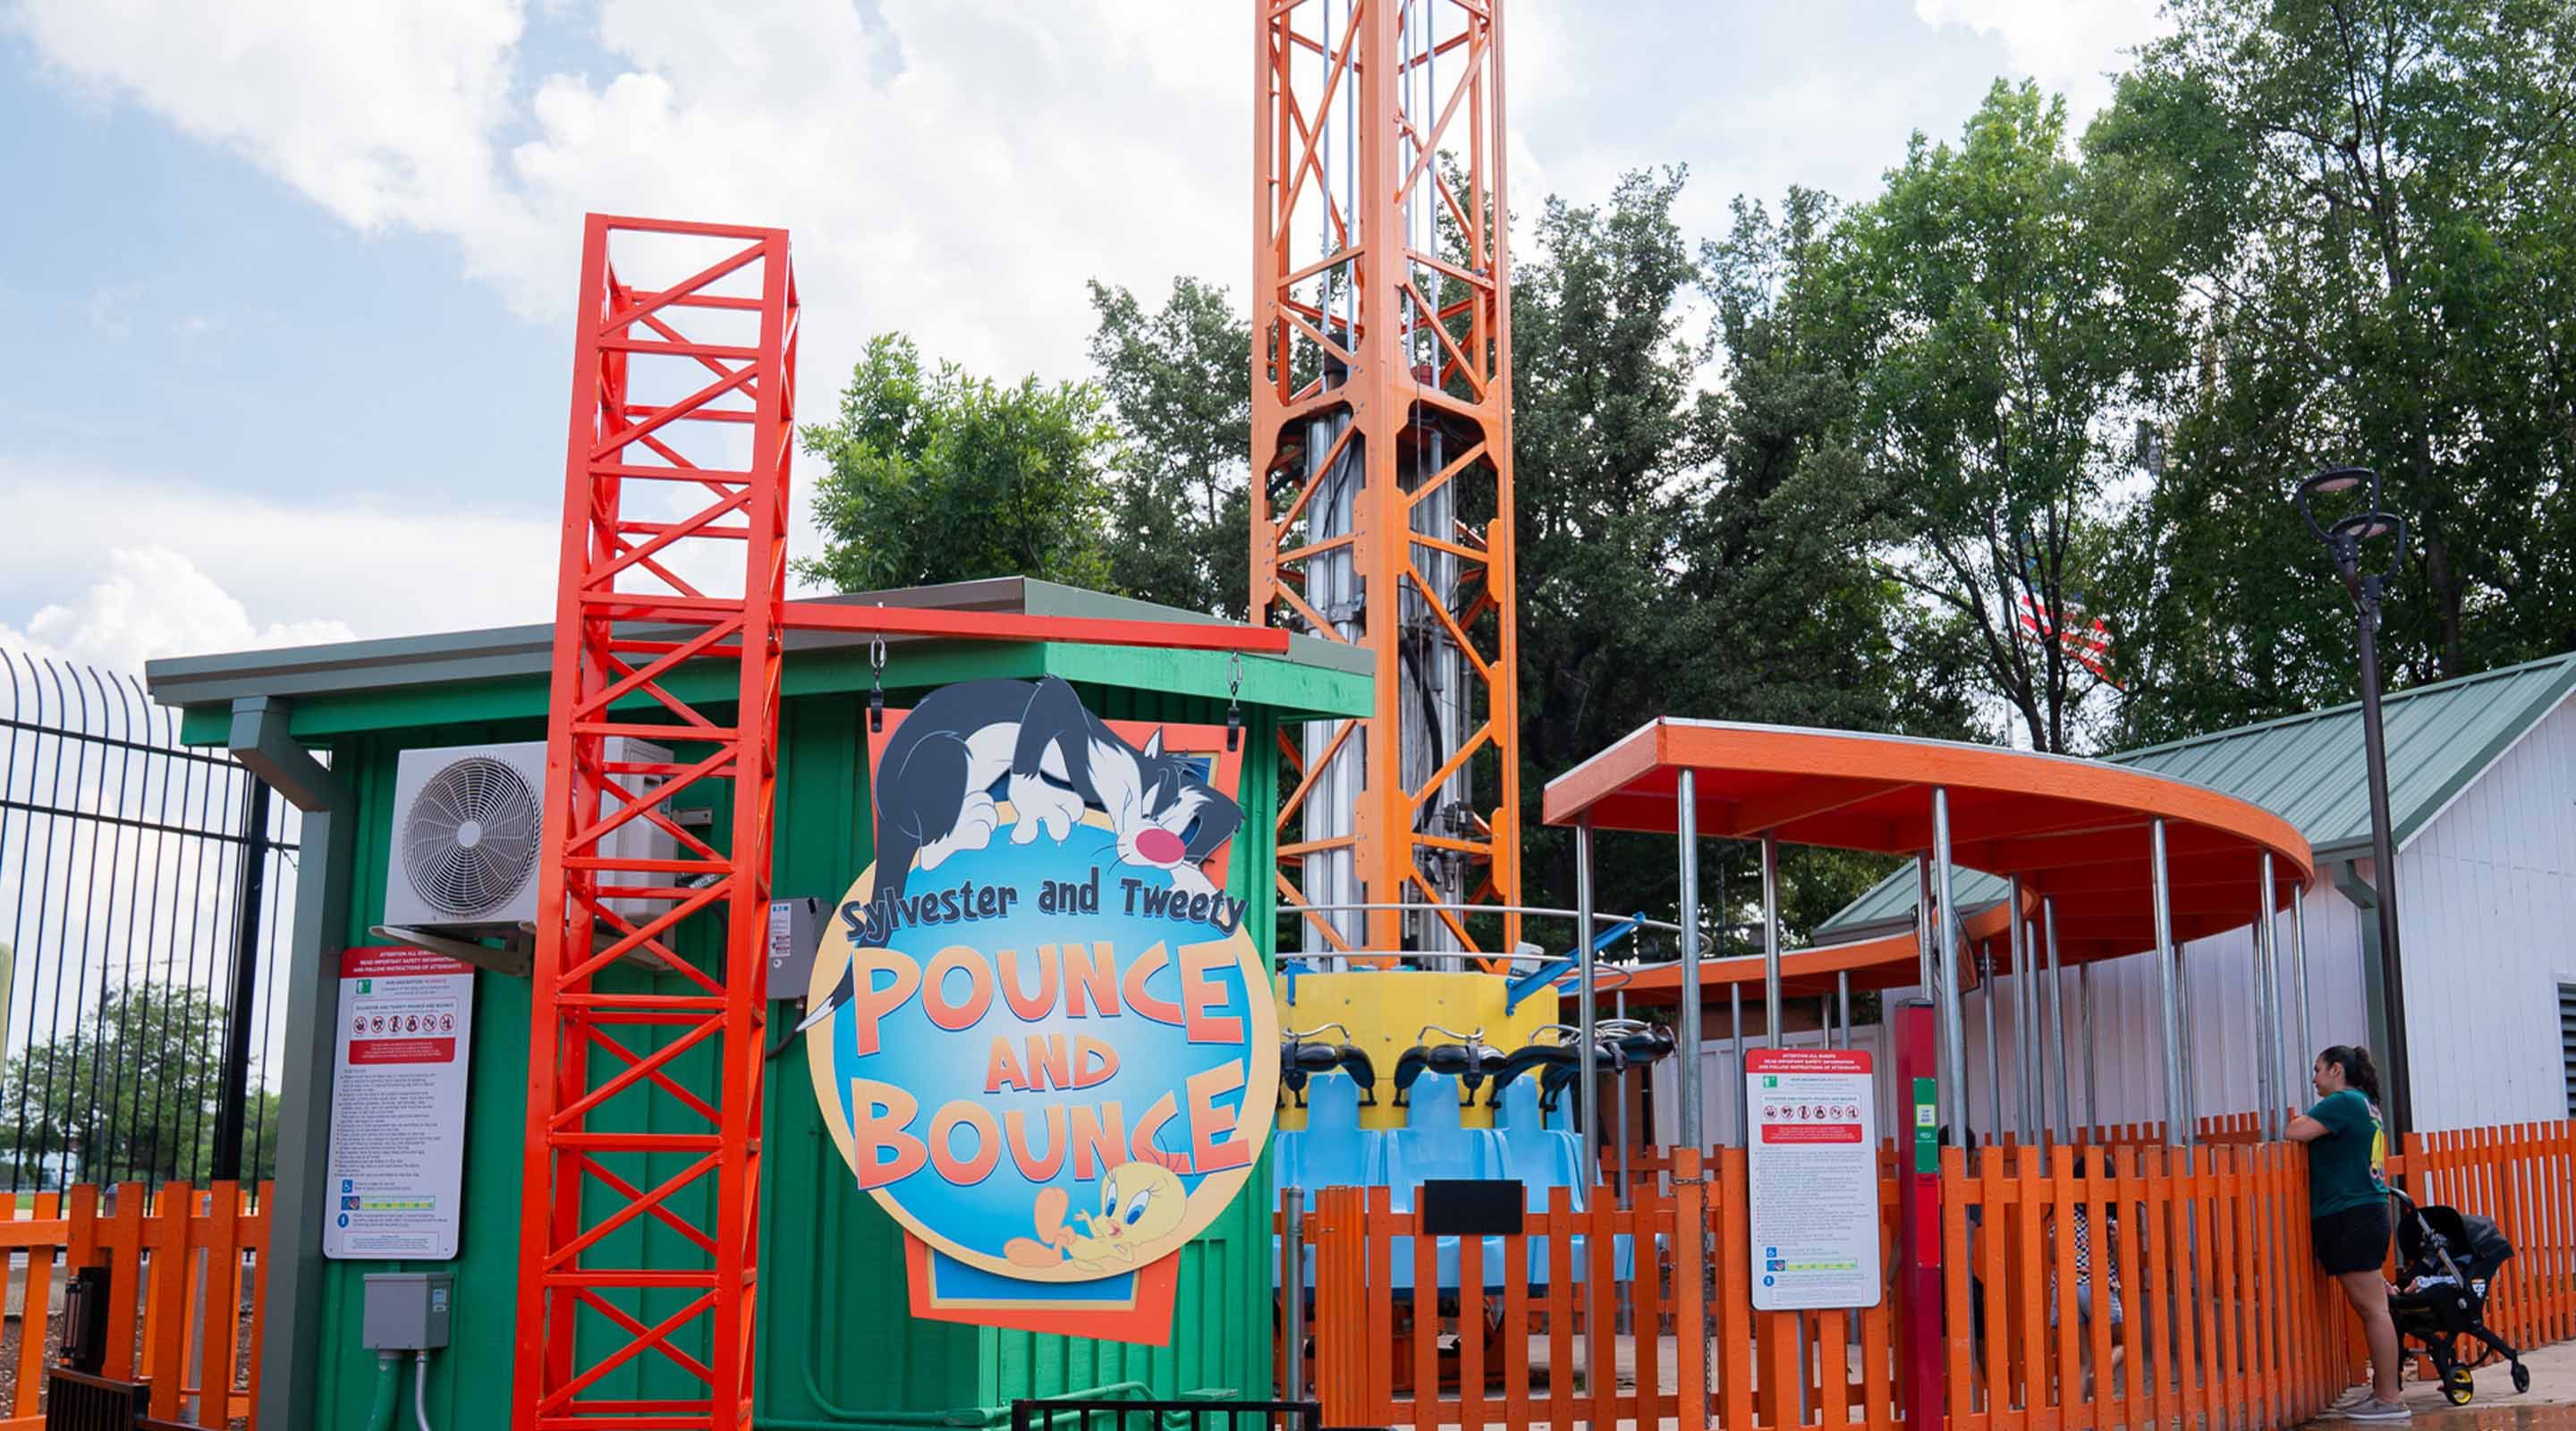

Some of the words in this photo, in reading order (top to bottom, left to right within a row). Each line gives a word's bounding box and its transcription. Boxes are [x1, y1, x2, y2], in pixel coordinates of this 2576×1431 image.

[840, 880, 1018, 942] Sylvester
[1038, 867, 1100, 916] and
[1120, 878, 1250, 936] Tweety
[852, 939, 1244, 1057] POUNCE
[985, 1032, 1120, 1093] AND
[851, 1058, 1252, 1190] BOUNCE
